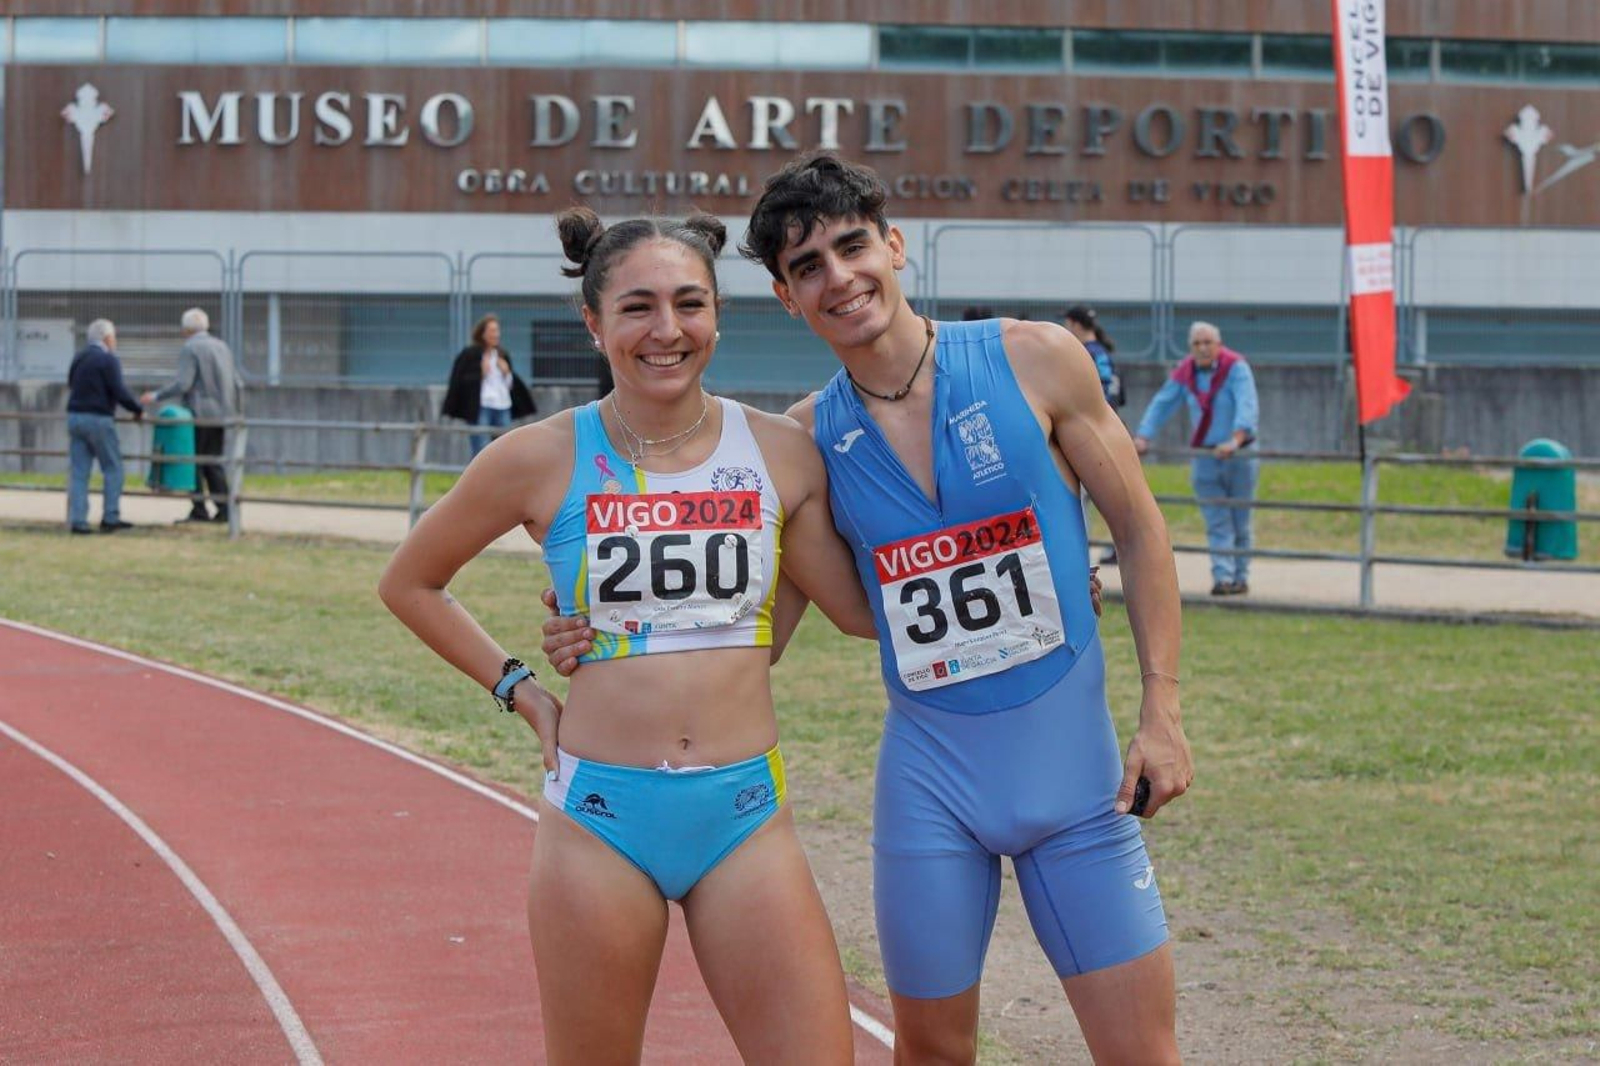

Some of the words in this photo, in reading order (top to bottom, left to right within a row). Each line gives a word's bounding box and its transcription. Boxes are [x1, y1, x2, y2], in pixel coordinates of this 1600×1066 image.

[177, 91, 475, 147] MUSEO
[530, 95, 638, 149] DE
[686, 96, 908, 151] ARTE
[965, 102, 1446, 165] DEPORTIO
[1368, 74, 1382, 117] DE
[457, 168, 549, 194] OBRA
[574, 169, 751, 197] CULTURAL
[1003, 178, 1104, 204] CELTA
[1127, 180, 1170, 204] DE
[1191, 181, 1276, 207] VIGO
[598, 533, 750, 603] 260
[900, 552, 1034, 645] 361
